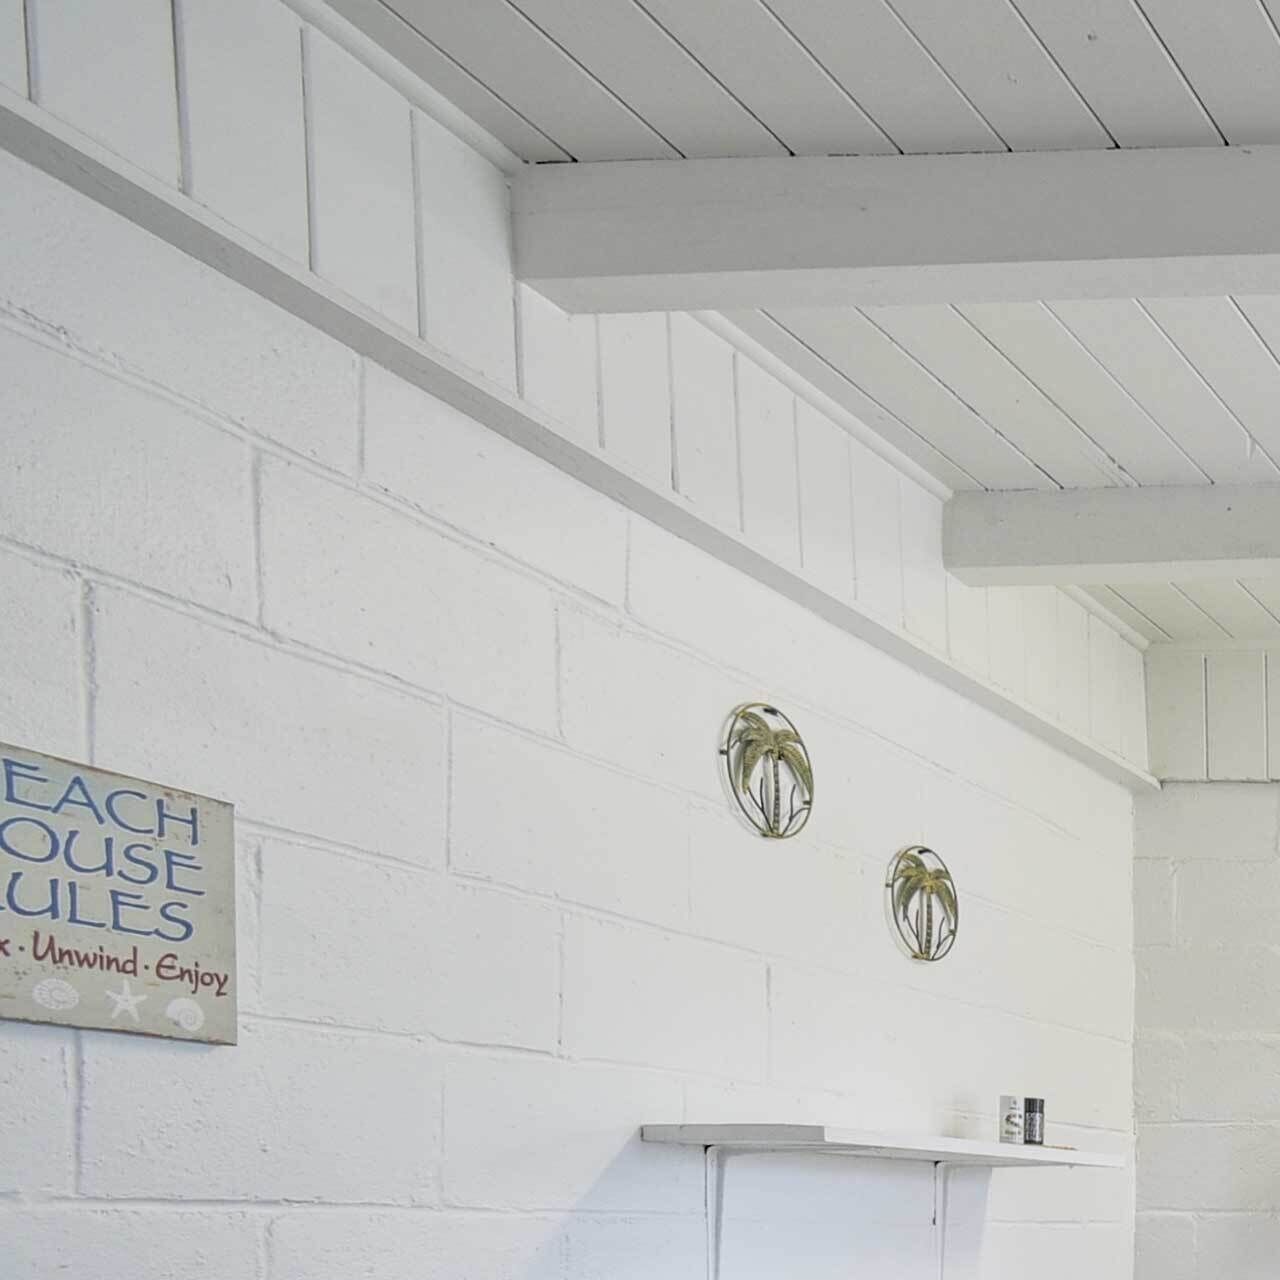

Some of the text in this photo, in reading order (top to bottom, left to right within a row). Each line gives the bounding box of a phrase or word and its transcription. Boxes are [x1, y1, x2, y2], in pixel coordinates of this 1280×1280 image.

[2, 757, 199, 846] EACH
[0, 816, 206, 896] OUSE
[0, 871, 194, 942] ULES
[32, 930, 139, 977] Unwind
[155, 953, 229, 997] Enjoy
